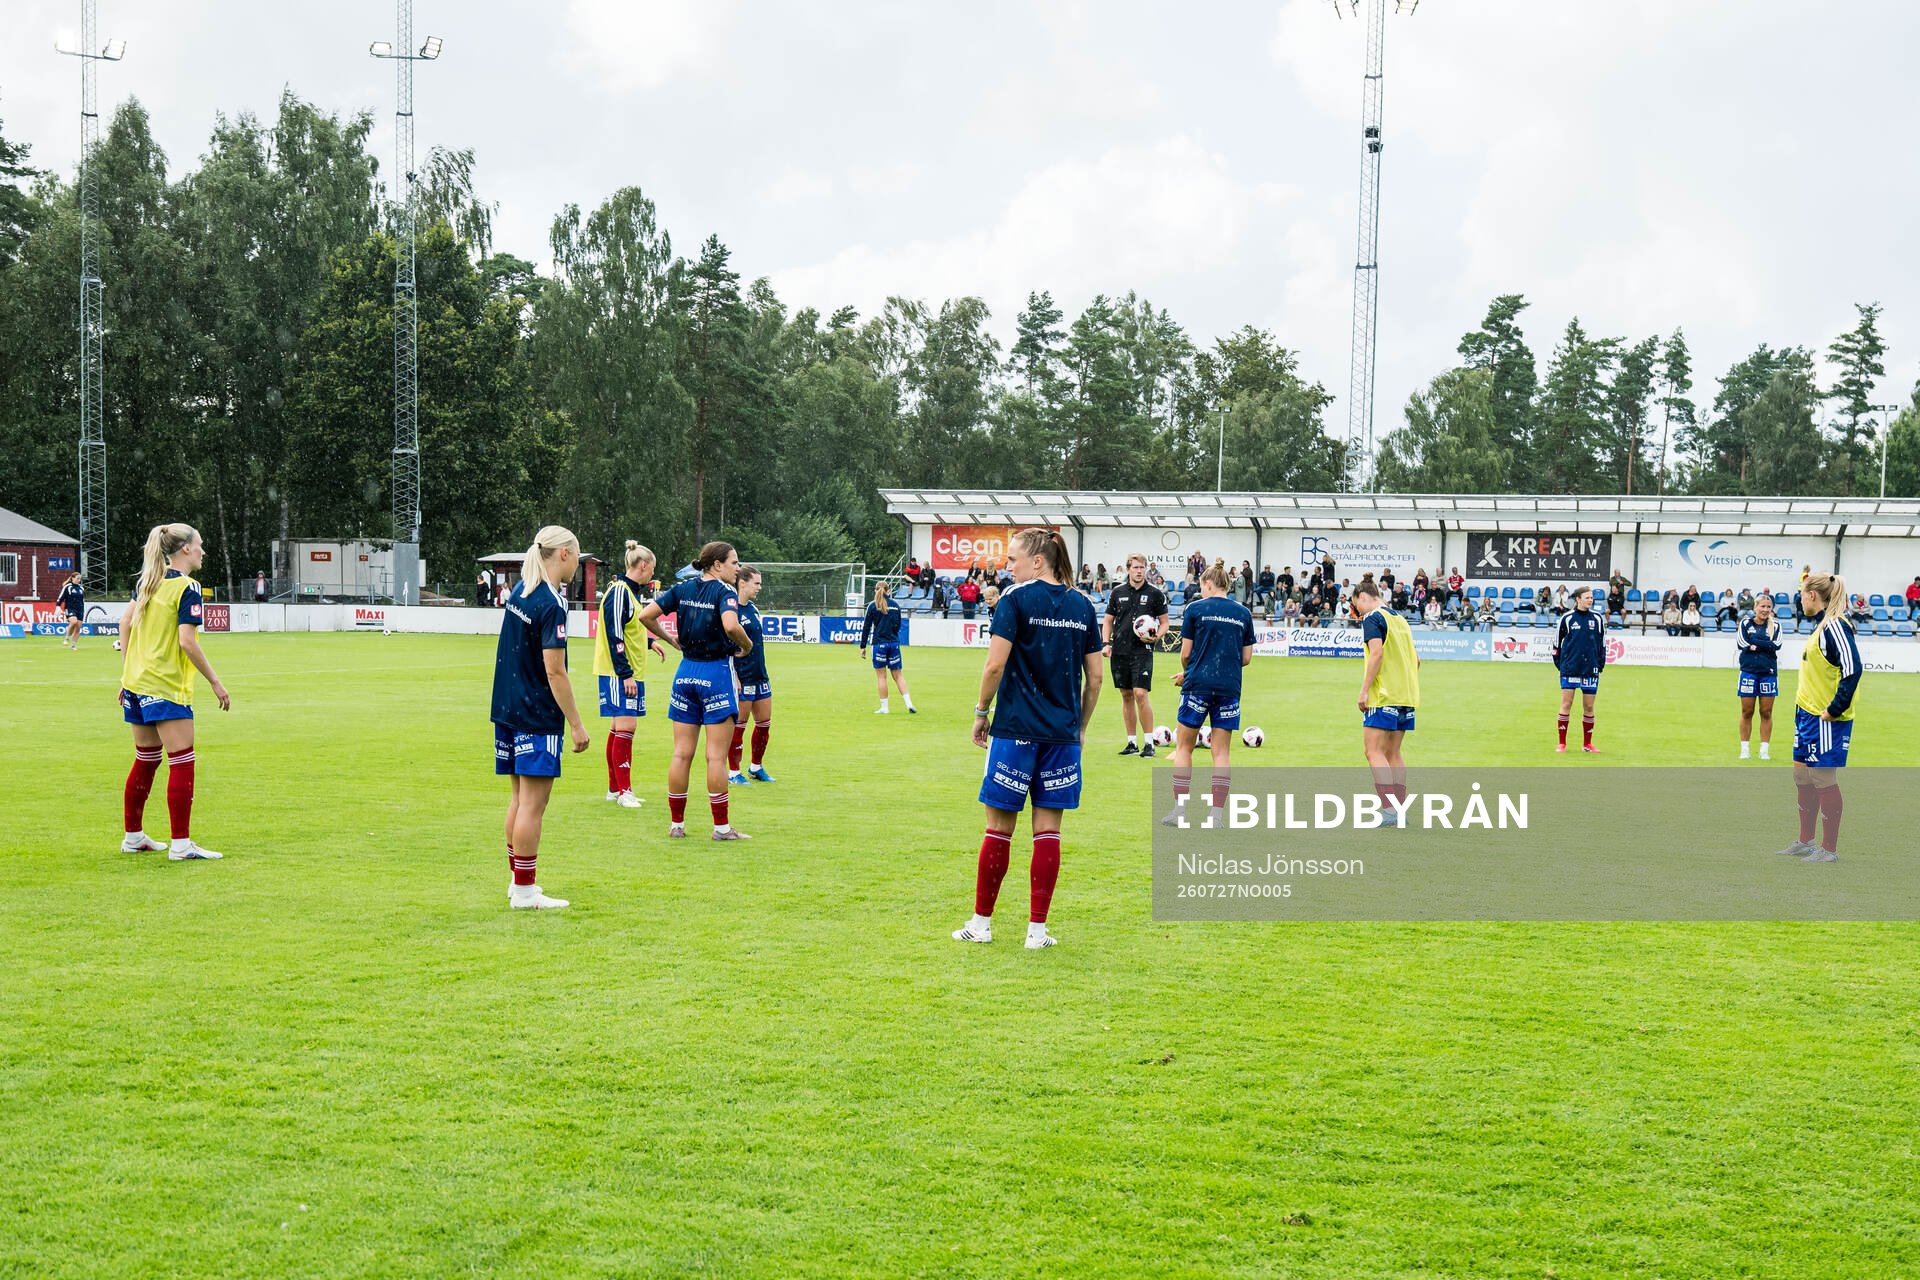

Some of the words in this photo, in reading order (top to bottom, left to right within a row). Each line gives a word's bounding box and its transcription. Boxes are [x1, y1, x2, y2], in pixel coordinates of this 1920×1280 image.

[936, 534, 1003, 555] clean
[1507, 537, 1602, 555] KREATIV
[1507, 557, 1597, 569] REKLAM
[1704, 554, 1741, 567] Vittsjö
[1745, 555, 1793, 568] Omsorg
[9, 606, 29, 623] ICA
[207, 609, 228, 618] FARO
[207, 617, 228, 627] ZON
[1291, 629, 1333, 645] Vittsjö
[1807, 743, 1817, 754] 15
